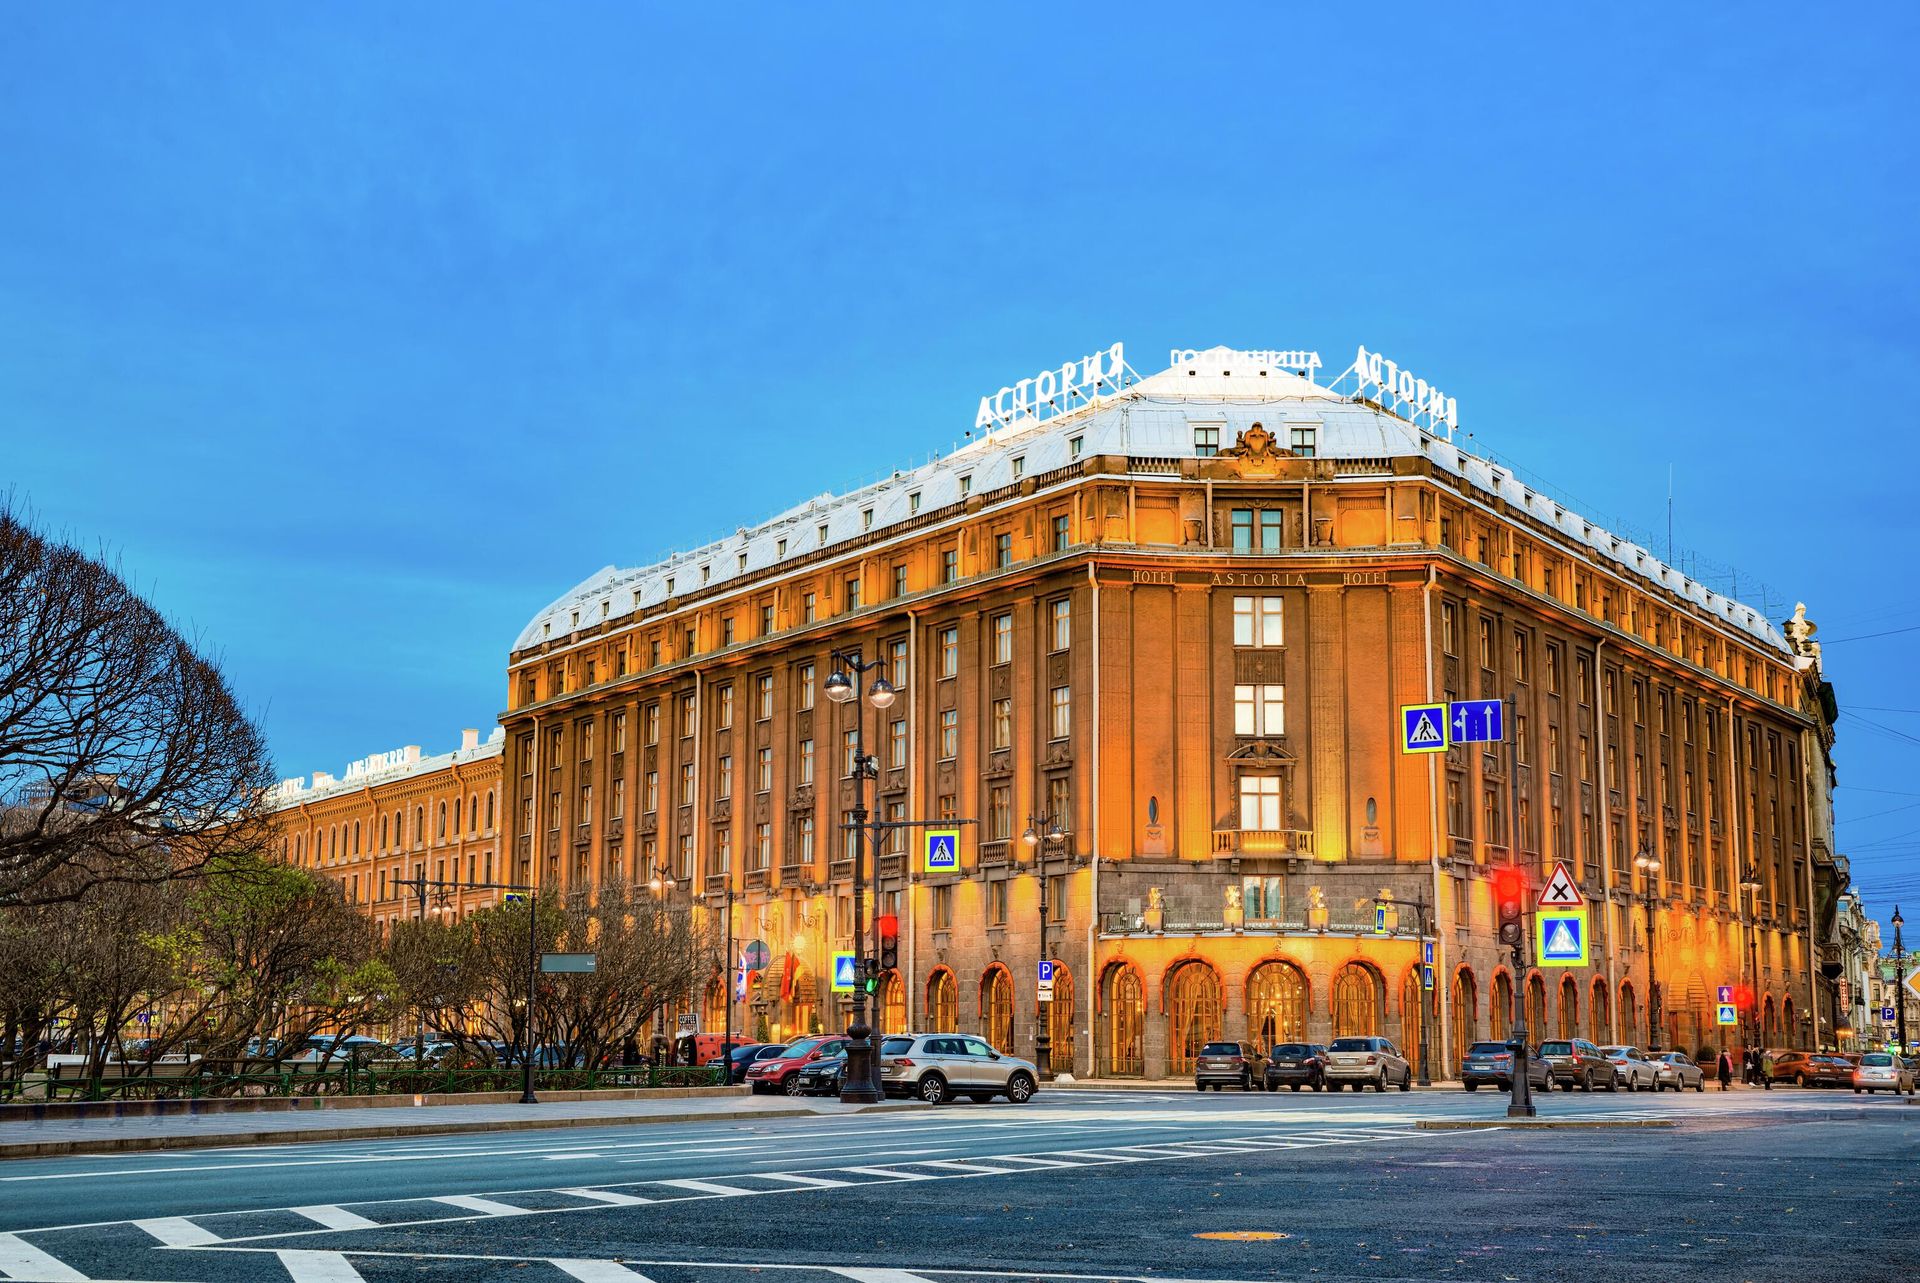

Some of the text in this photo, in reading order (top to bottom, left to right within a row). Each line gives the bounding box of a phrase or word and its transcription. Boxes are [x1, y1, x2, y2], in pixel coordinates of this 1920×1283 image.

[975, 342, 1123, 428] АСТОРИЯ
[1132, 570, 1176, 584] HOTEL
[1212, 573, 1306, 586] ASTORIA
[1342, 571, 1388, 585] HOTEL
[1042, 963, 1051, 979] P
[679, 1014, 696, 1024] COFFEE
[1885, 1008, 1893, 1019] P
